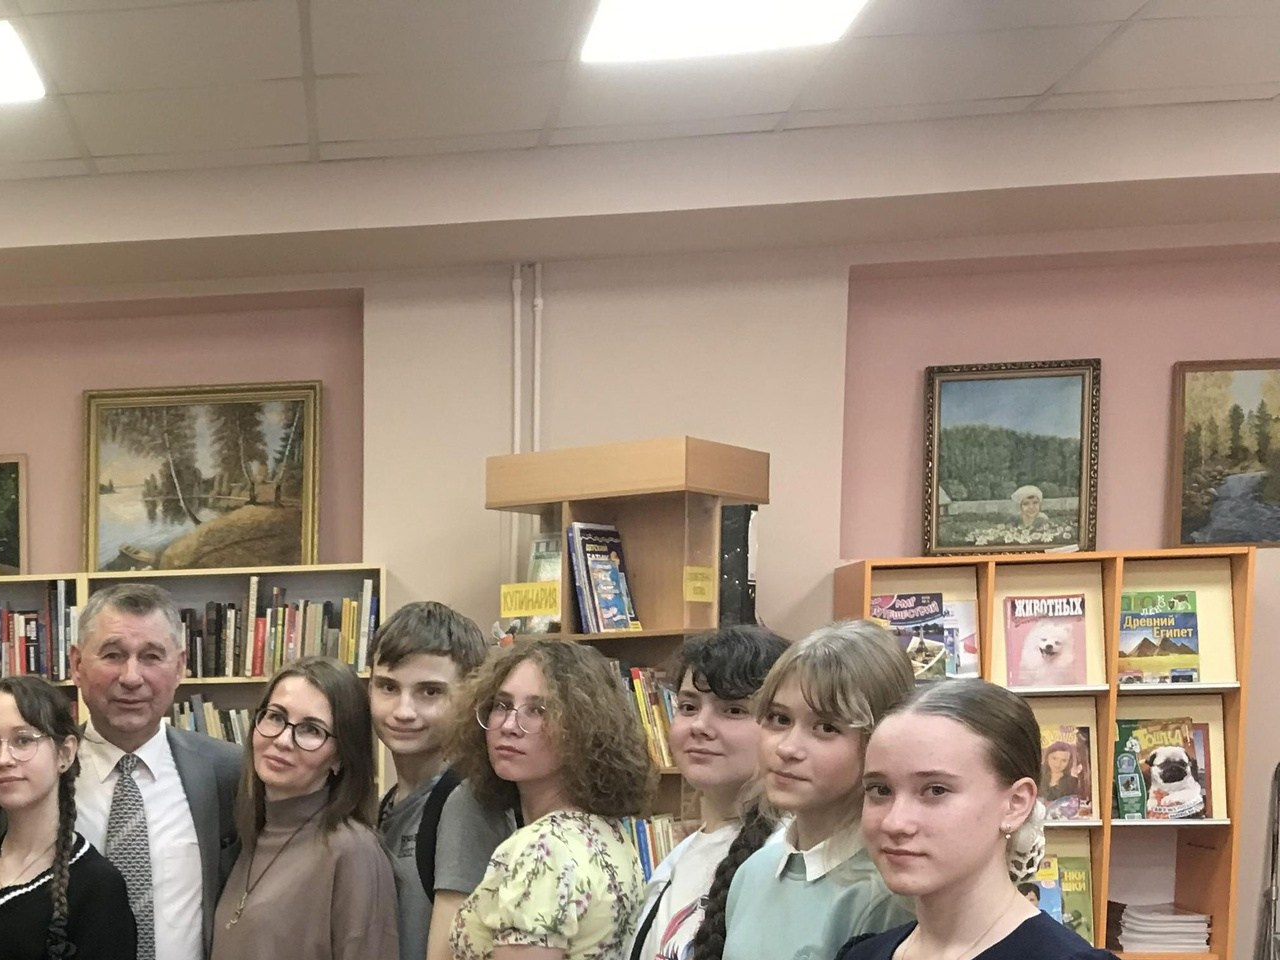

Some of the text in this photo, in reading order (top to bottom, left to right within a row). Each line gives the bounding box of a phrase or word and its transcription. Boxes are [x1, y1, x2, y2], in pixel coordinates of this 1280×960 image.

[1014, 597, 1083, 617] ЖИВОТНЫХ
[1123, 614, 1176, 630] Древний
[1153, 626, 1194, 638] Египет
